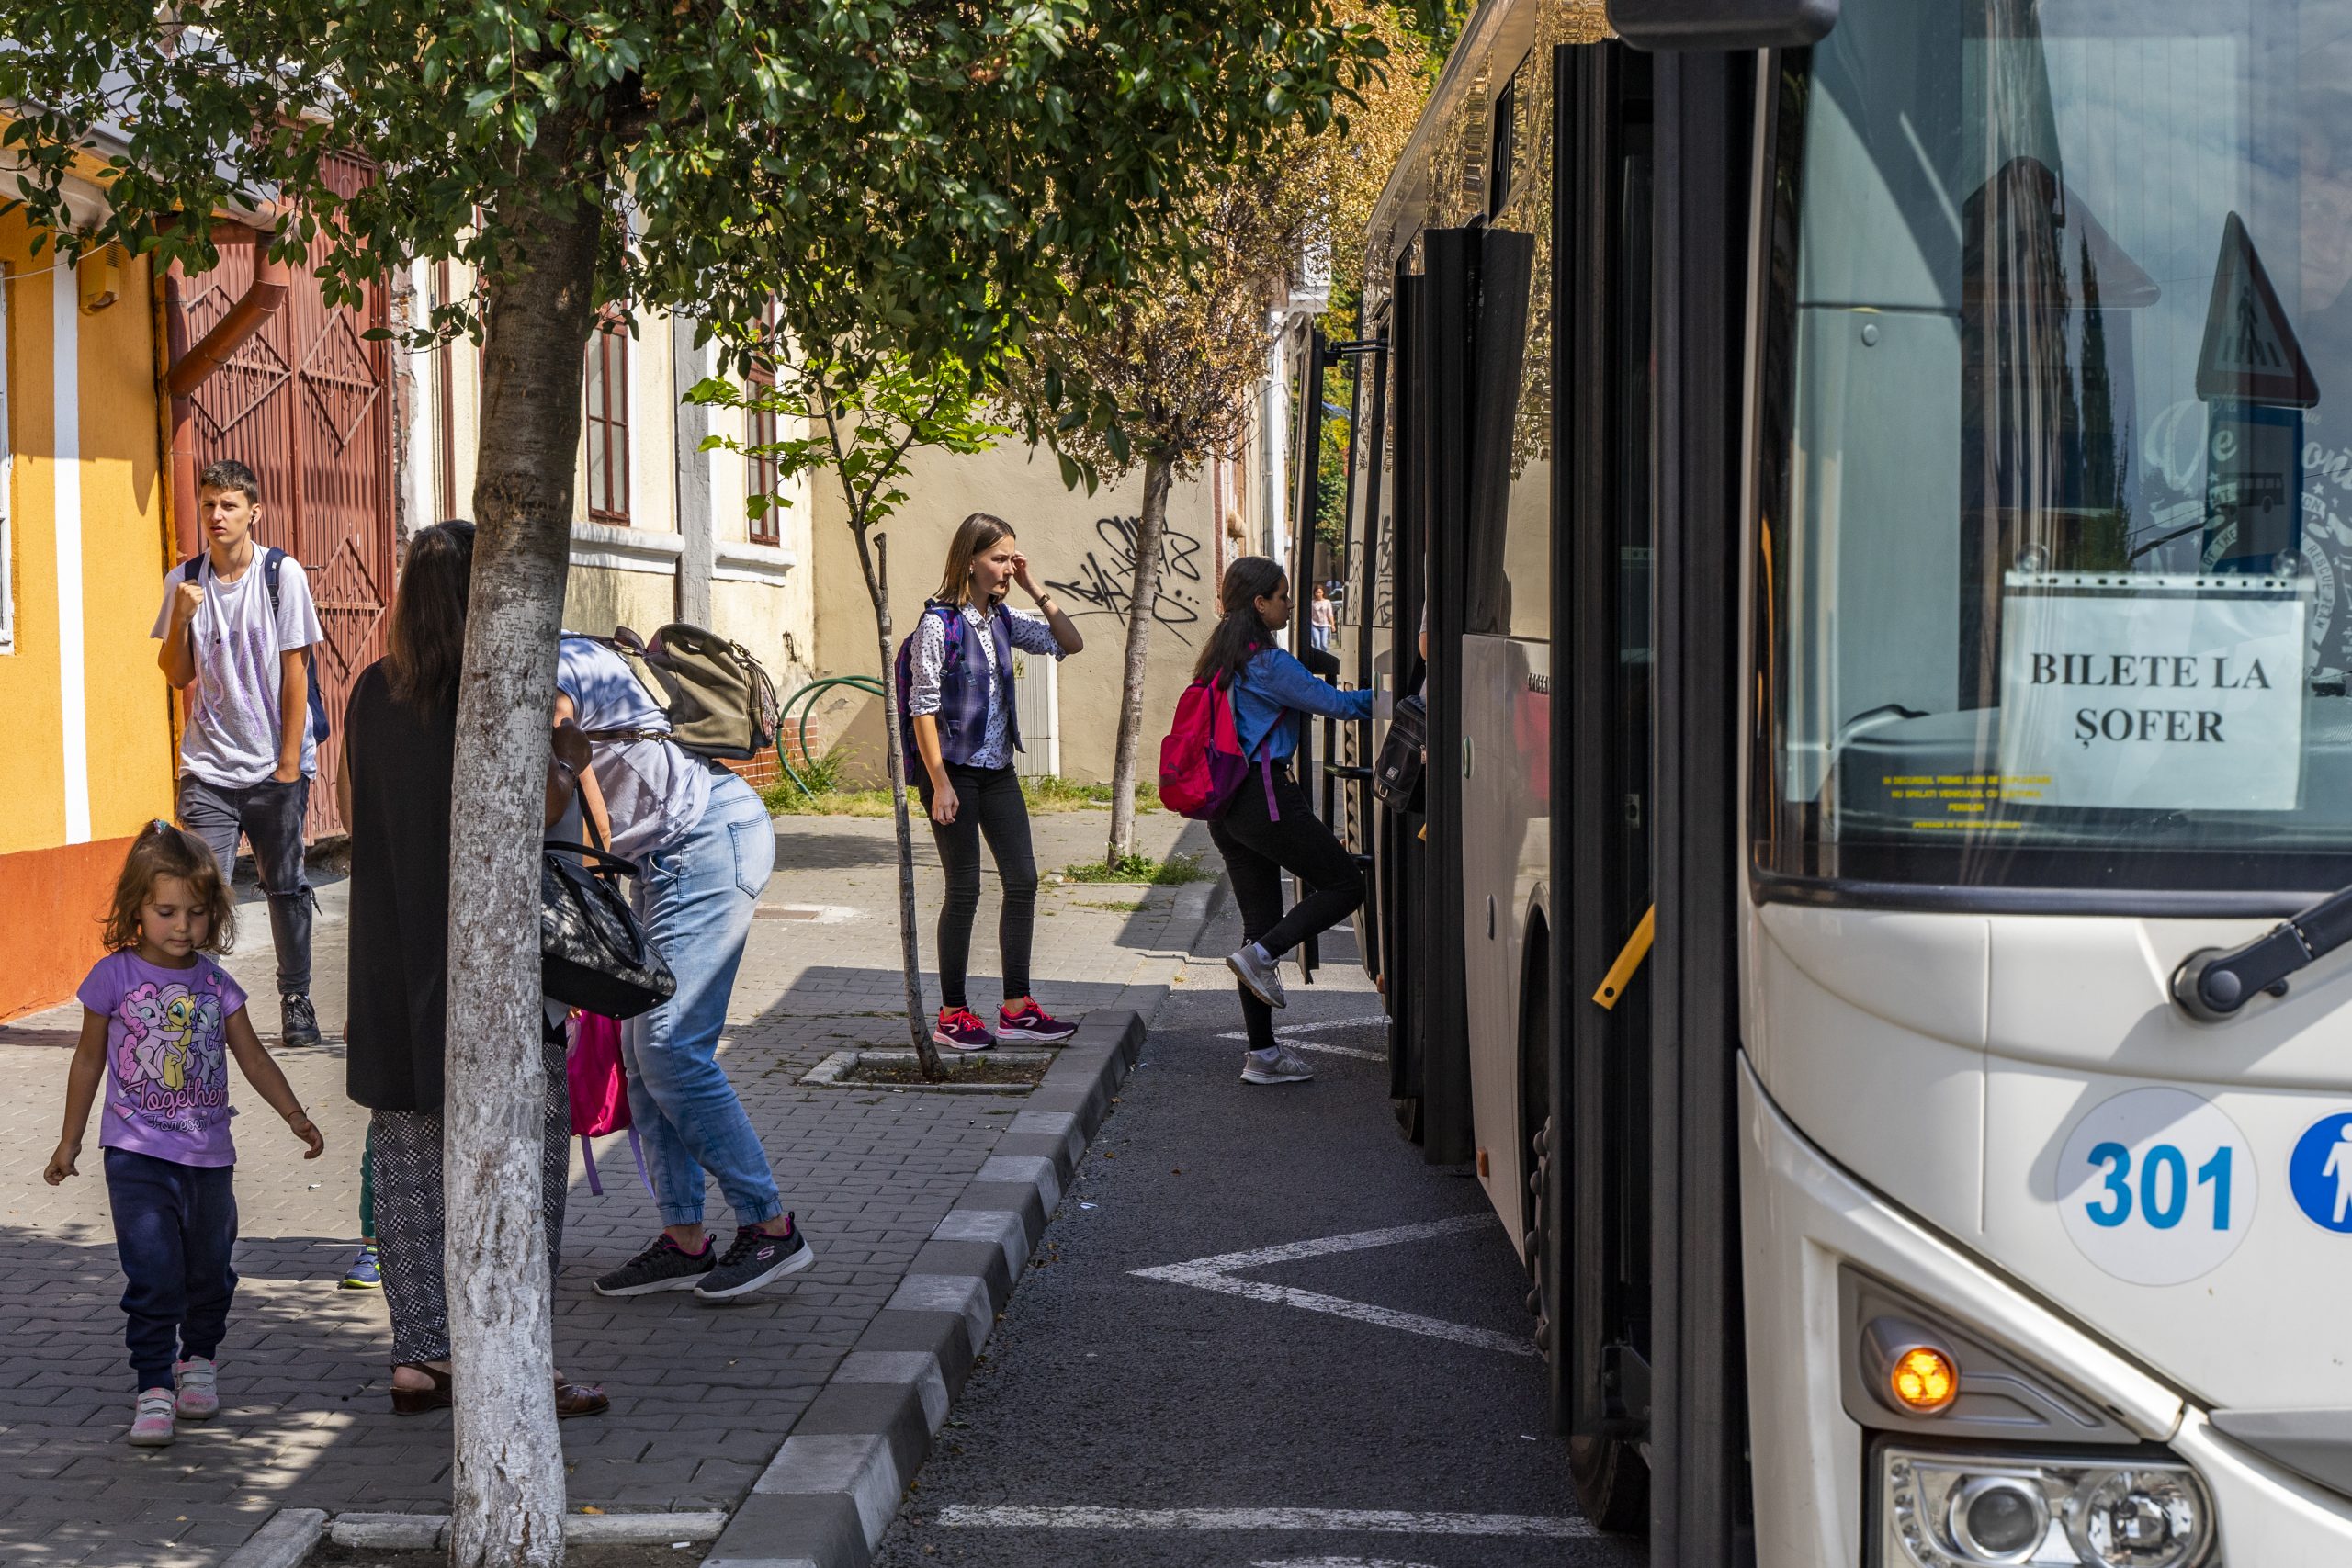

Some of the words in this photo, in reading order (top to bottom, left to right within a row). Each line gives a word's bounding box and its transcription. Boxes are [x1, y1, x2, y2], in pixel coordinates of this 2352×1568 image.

[2030, 652, 2198, 688] BILETE
[2212, 656, 2271, 691] LA
[2075, 707, 2225, 750] ȘOFER
[125, 1077, 227, 1118] Together
[142, 1113, 208, 1132] Forever
[2085, 1142, 2233, 1231] 301
